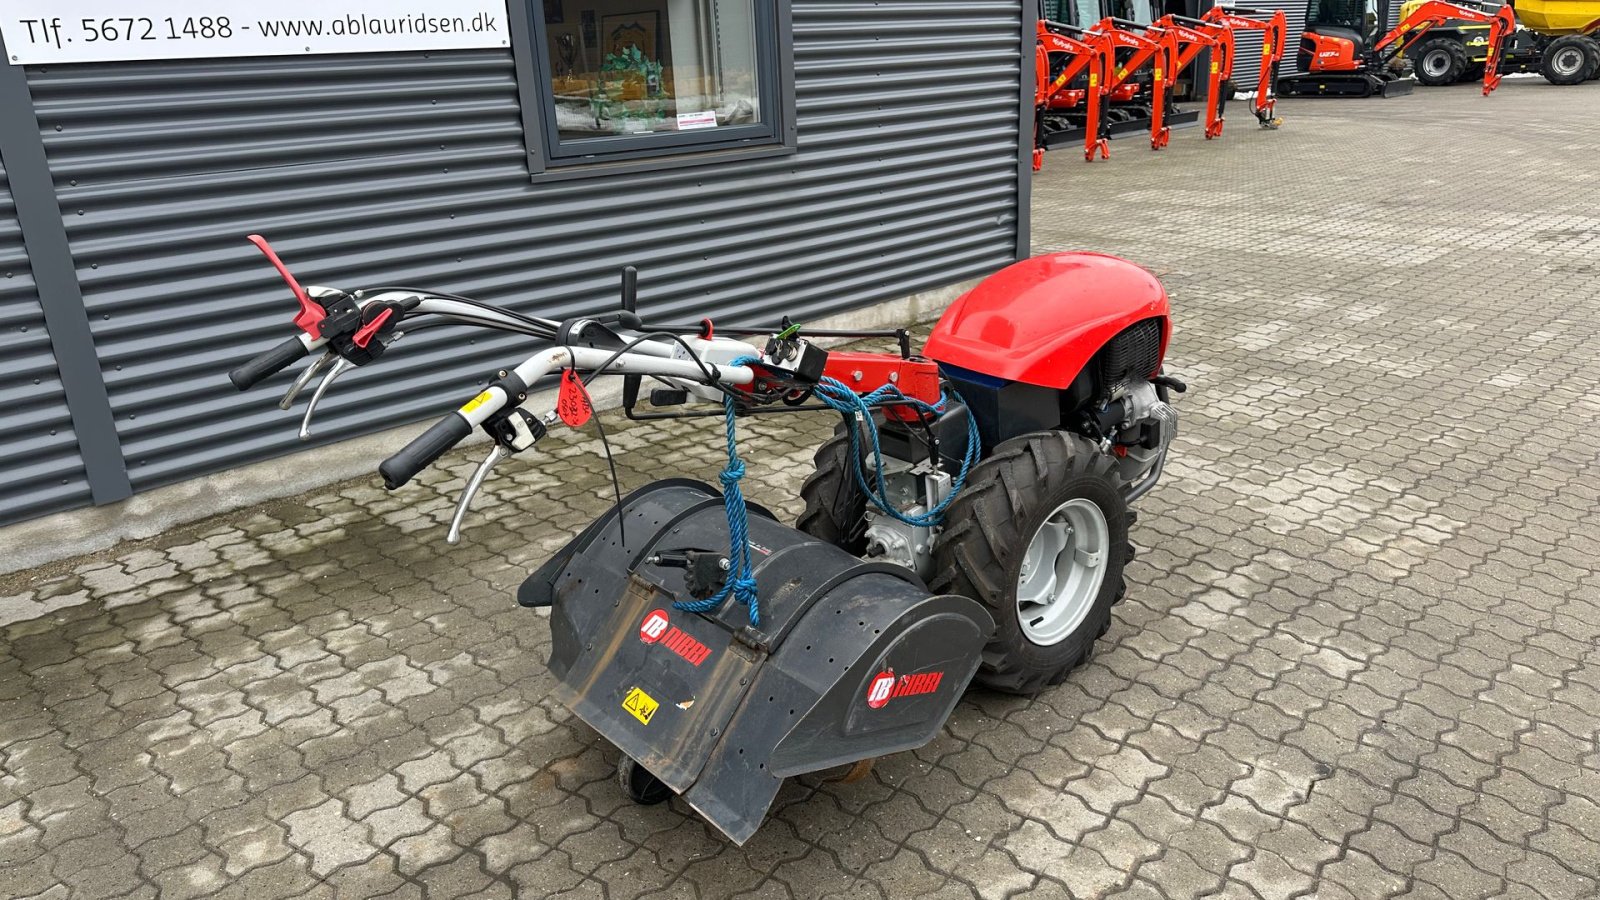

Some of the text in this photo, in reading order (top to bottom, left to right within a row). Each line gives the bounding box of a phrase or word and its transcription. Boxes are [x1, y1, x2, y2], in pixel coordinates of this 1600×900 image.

[19, 17, 72, 49] Tlf.
[81, 16, 157, 42] 5672
[164, 15, 233, 40] 1488
[257, 11, 498, 38] www.ablauridsen.dk
[1119, 33, 1139, 46] Kubota
[1052, 37, 1074, 51] Kubota
[660, 626, 714, 667] NIBBI
